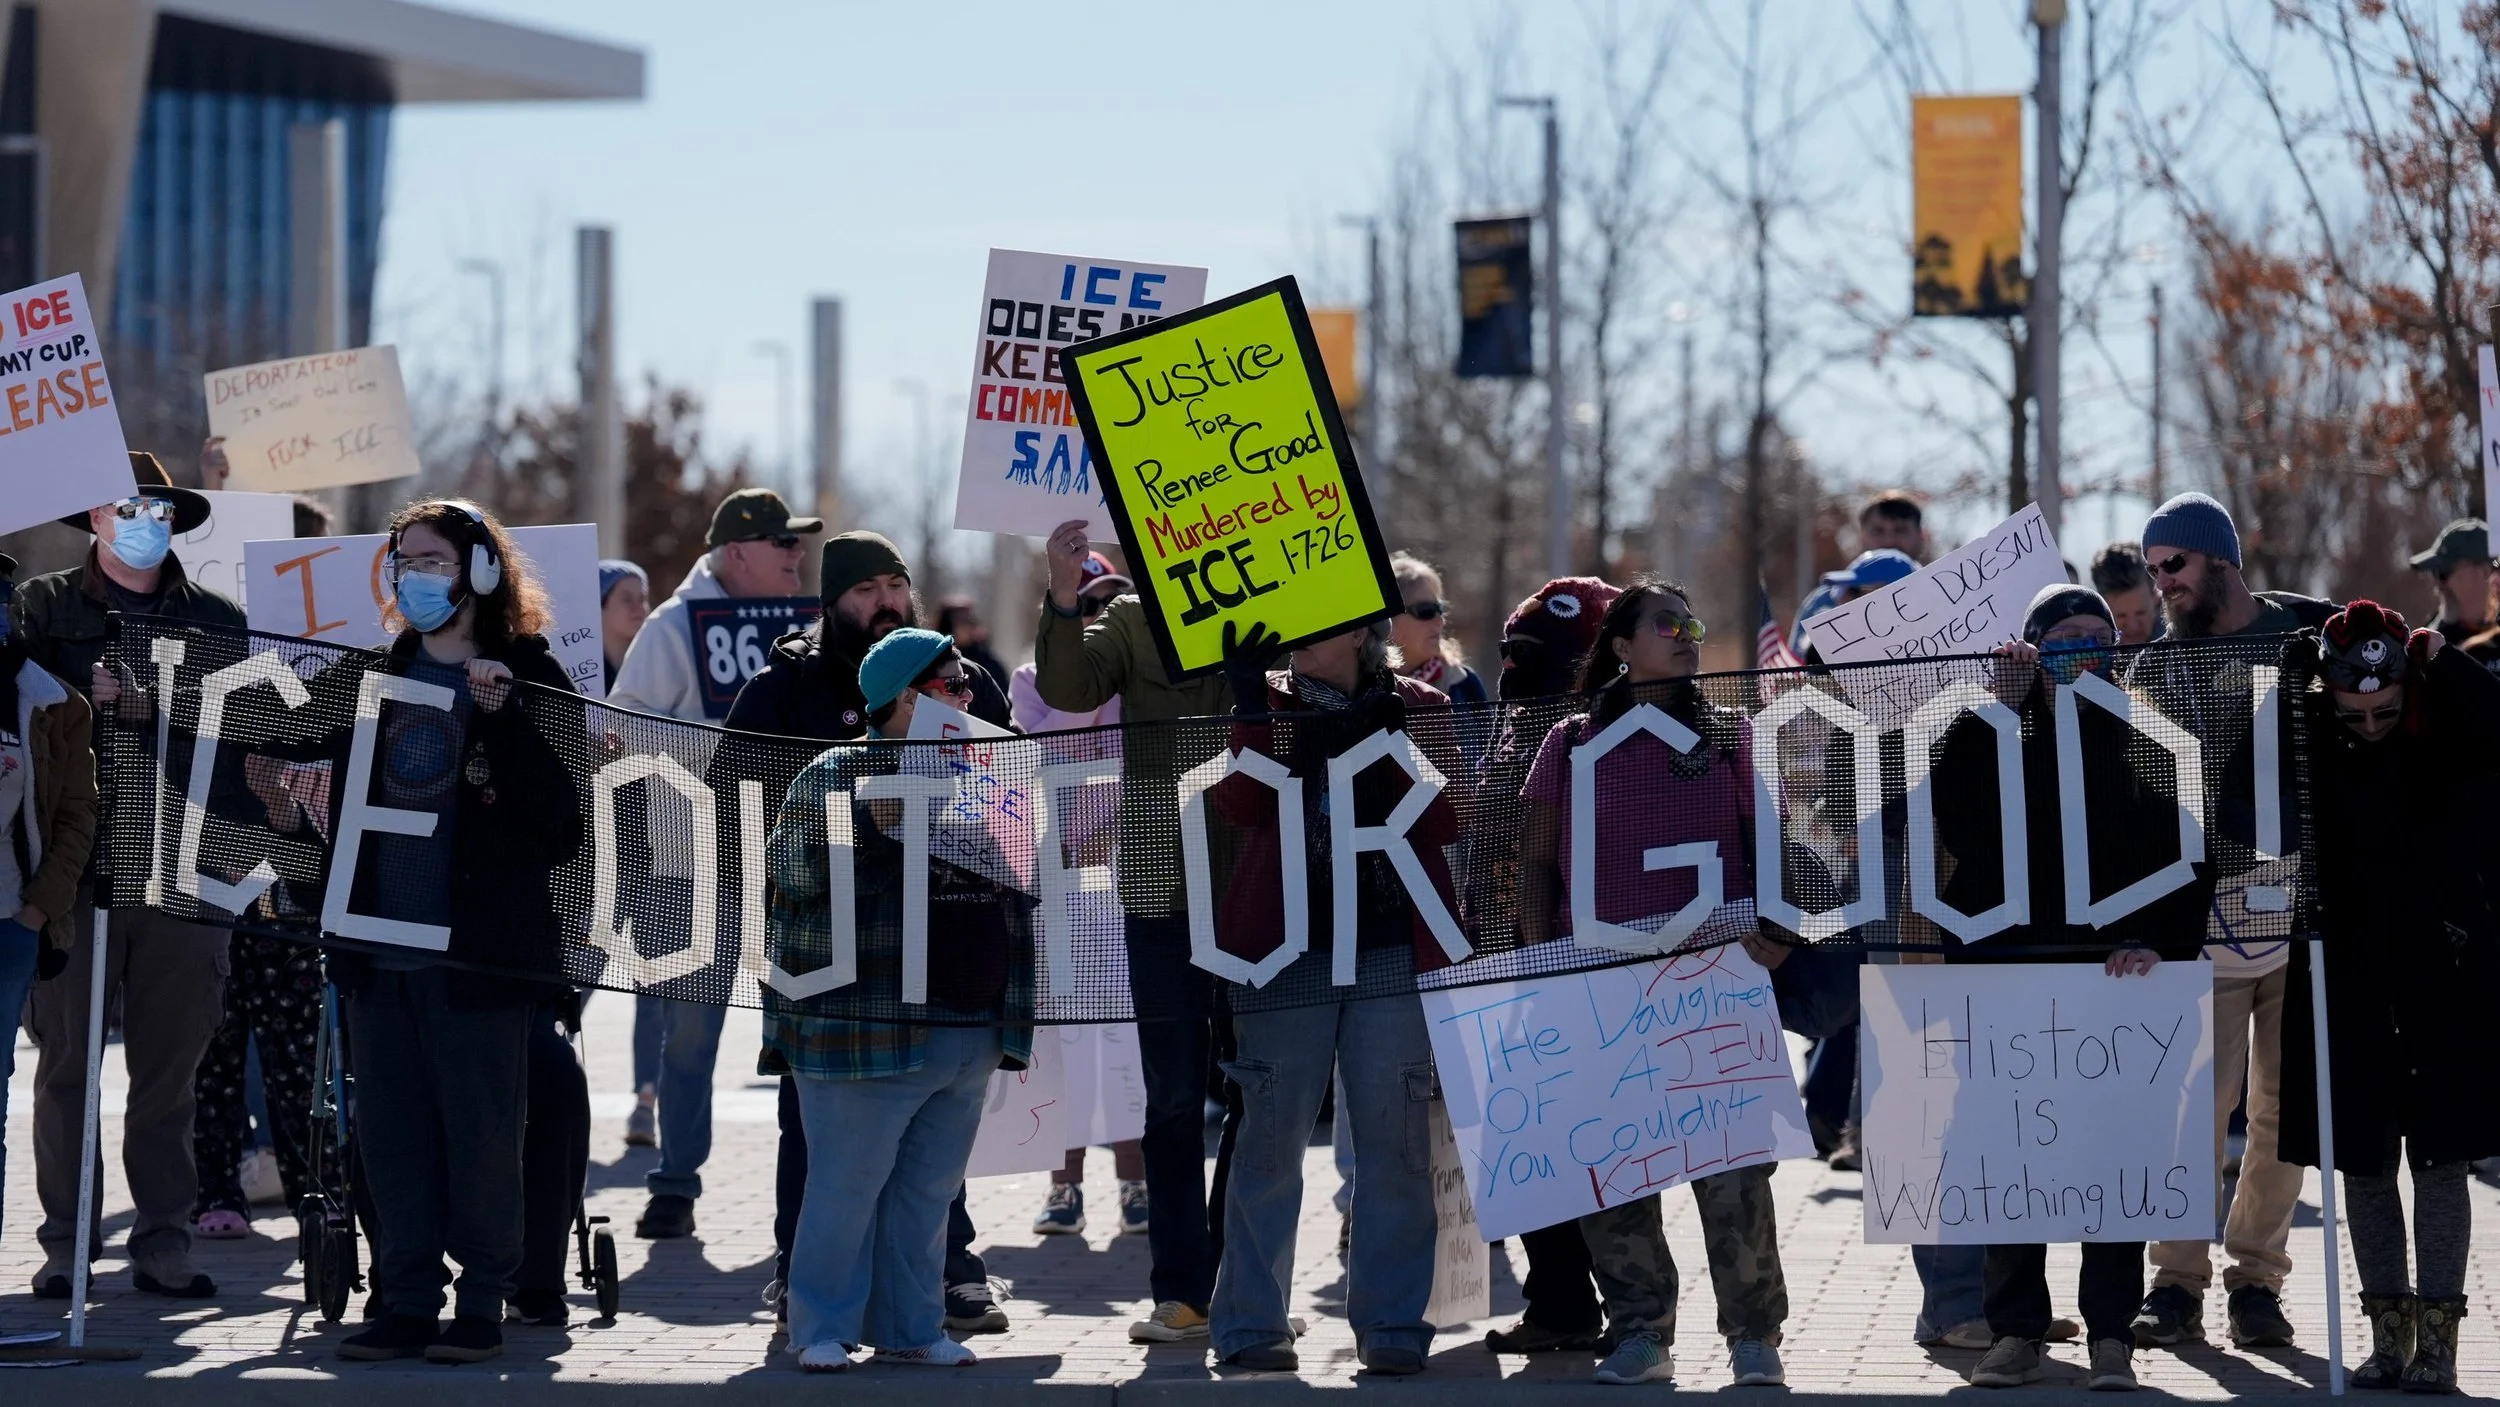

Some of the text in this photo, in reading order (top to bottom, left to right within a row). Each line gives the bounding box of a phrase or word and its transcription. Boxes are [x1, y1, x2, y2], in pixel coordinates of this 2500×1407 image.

[13, 289, 73, 337] ICE
[986, 298, 1105, 343] DOES
[1060, 264, 1167, 311] ICE
[39, 334, 90, 362] CUP,
[214, 352, 358, 405] DEPORTATION
[1096, 338, 1284, 427] Justice
[267, 433, 319, 471] FUCK
[1134, 409, 1325, 511] Renee Good
[1145, 474, 1341, 559] Murdered by
[1931, 513, 2048, 605] DOESN'T
[561, 627, 595, 647] FOR
[706, 624, 766, 685] 86
[1882, 594, 1999, 660] PROTECT
[145, 637, 2292, 1004] ICE OUT FOR GOOD!
[1584, 965, 1775, 1050] Daughter
[1922, 994, 2184, 1085] History
[1486, 1070, 1574, 1134] OF
[1610, 1044, 1663, 1098] A
[1657, 1009, 1778, 1082] JEW
[2014, 1089, 2059, 1148] is
[1587, 1129, 1775, 1208] KILL
[1866, 1146, 2105, 1235] Watching
